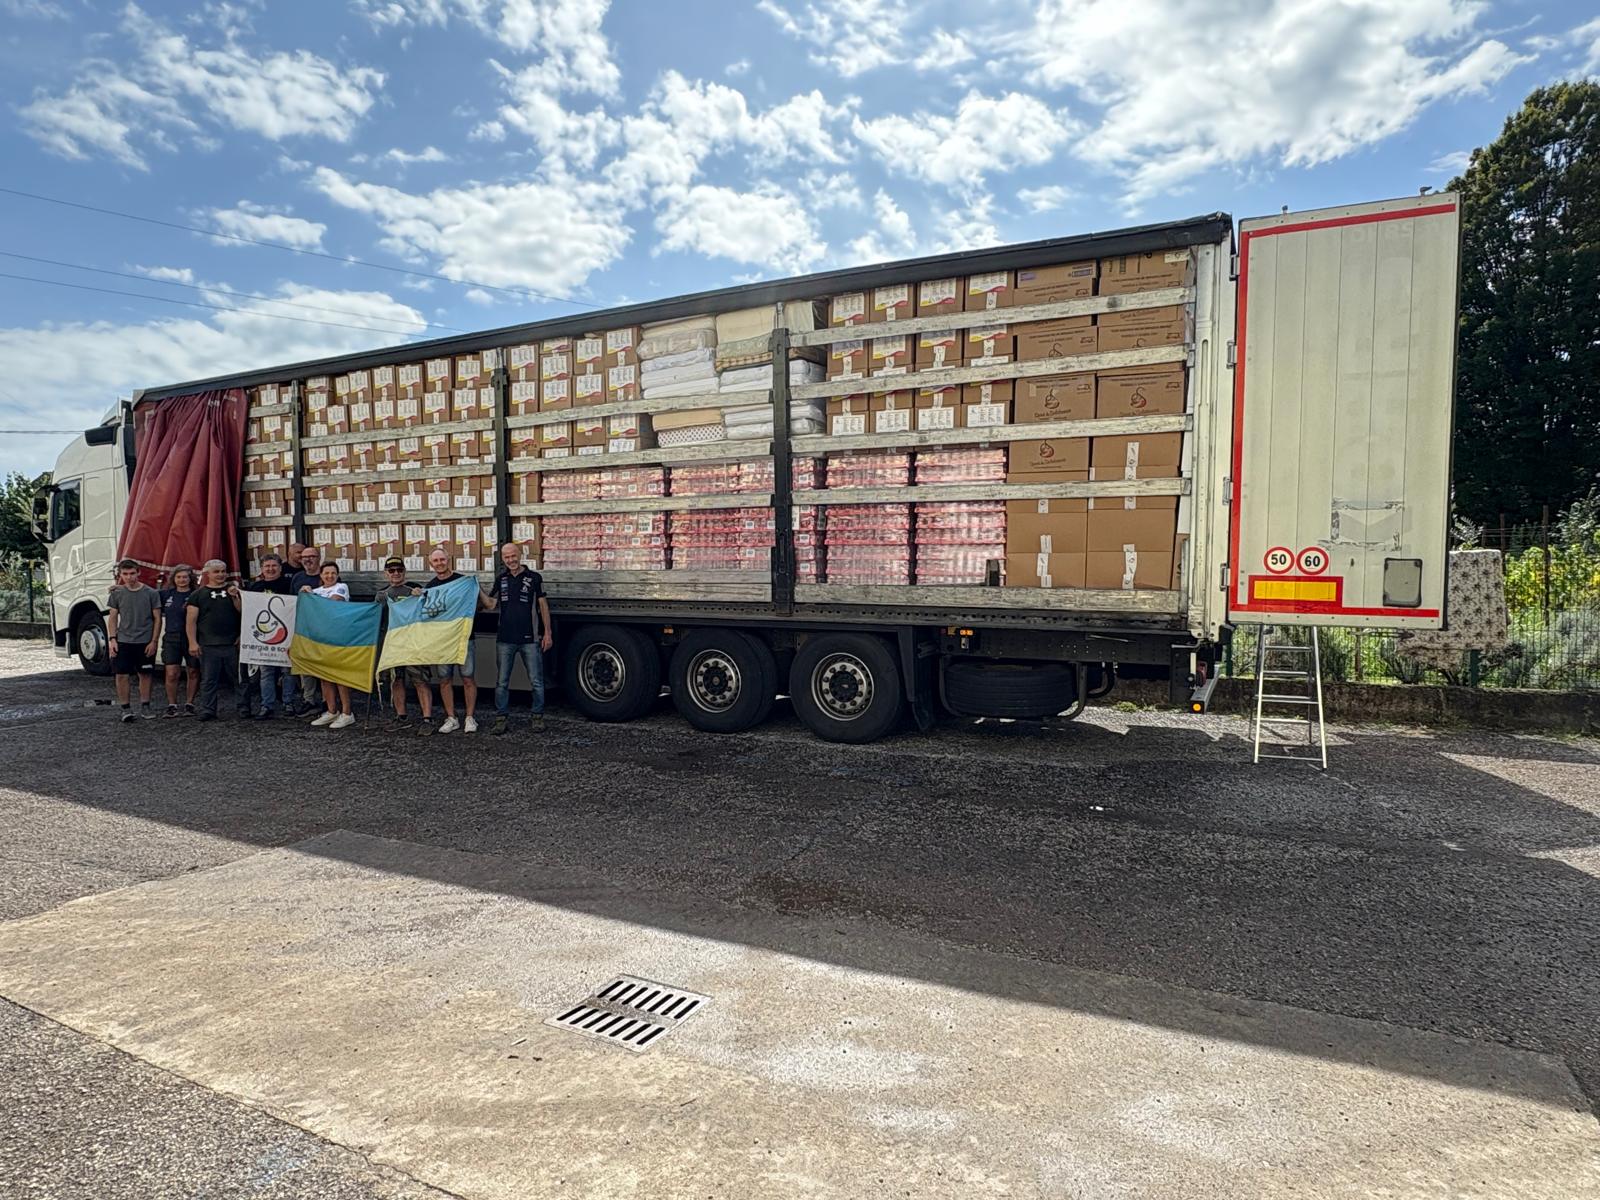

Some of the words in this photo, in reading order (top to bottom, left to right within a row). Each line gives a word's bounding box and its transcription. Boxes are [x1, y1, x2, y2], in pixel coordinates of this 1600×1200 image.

[1271, 554, 1287, 565] 50
[1304, 555, 1321, 567] 60
[242, 644, 269, 652] energia
